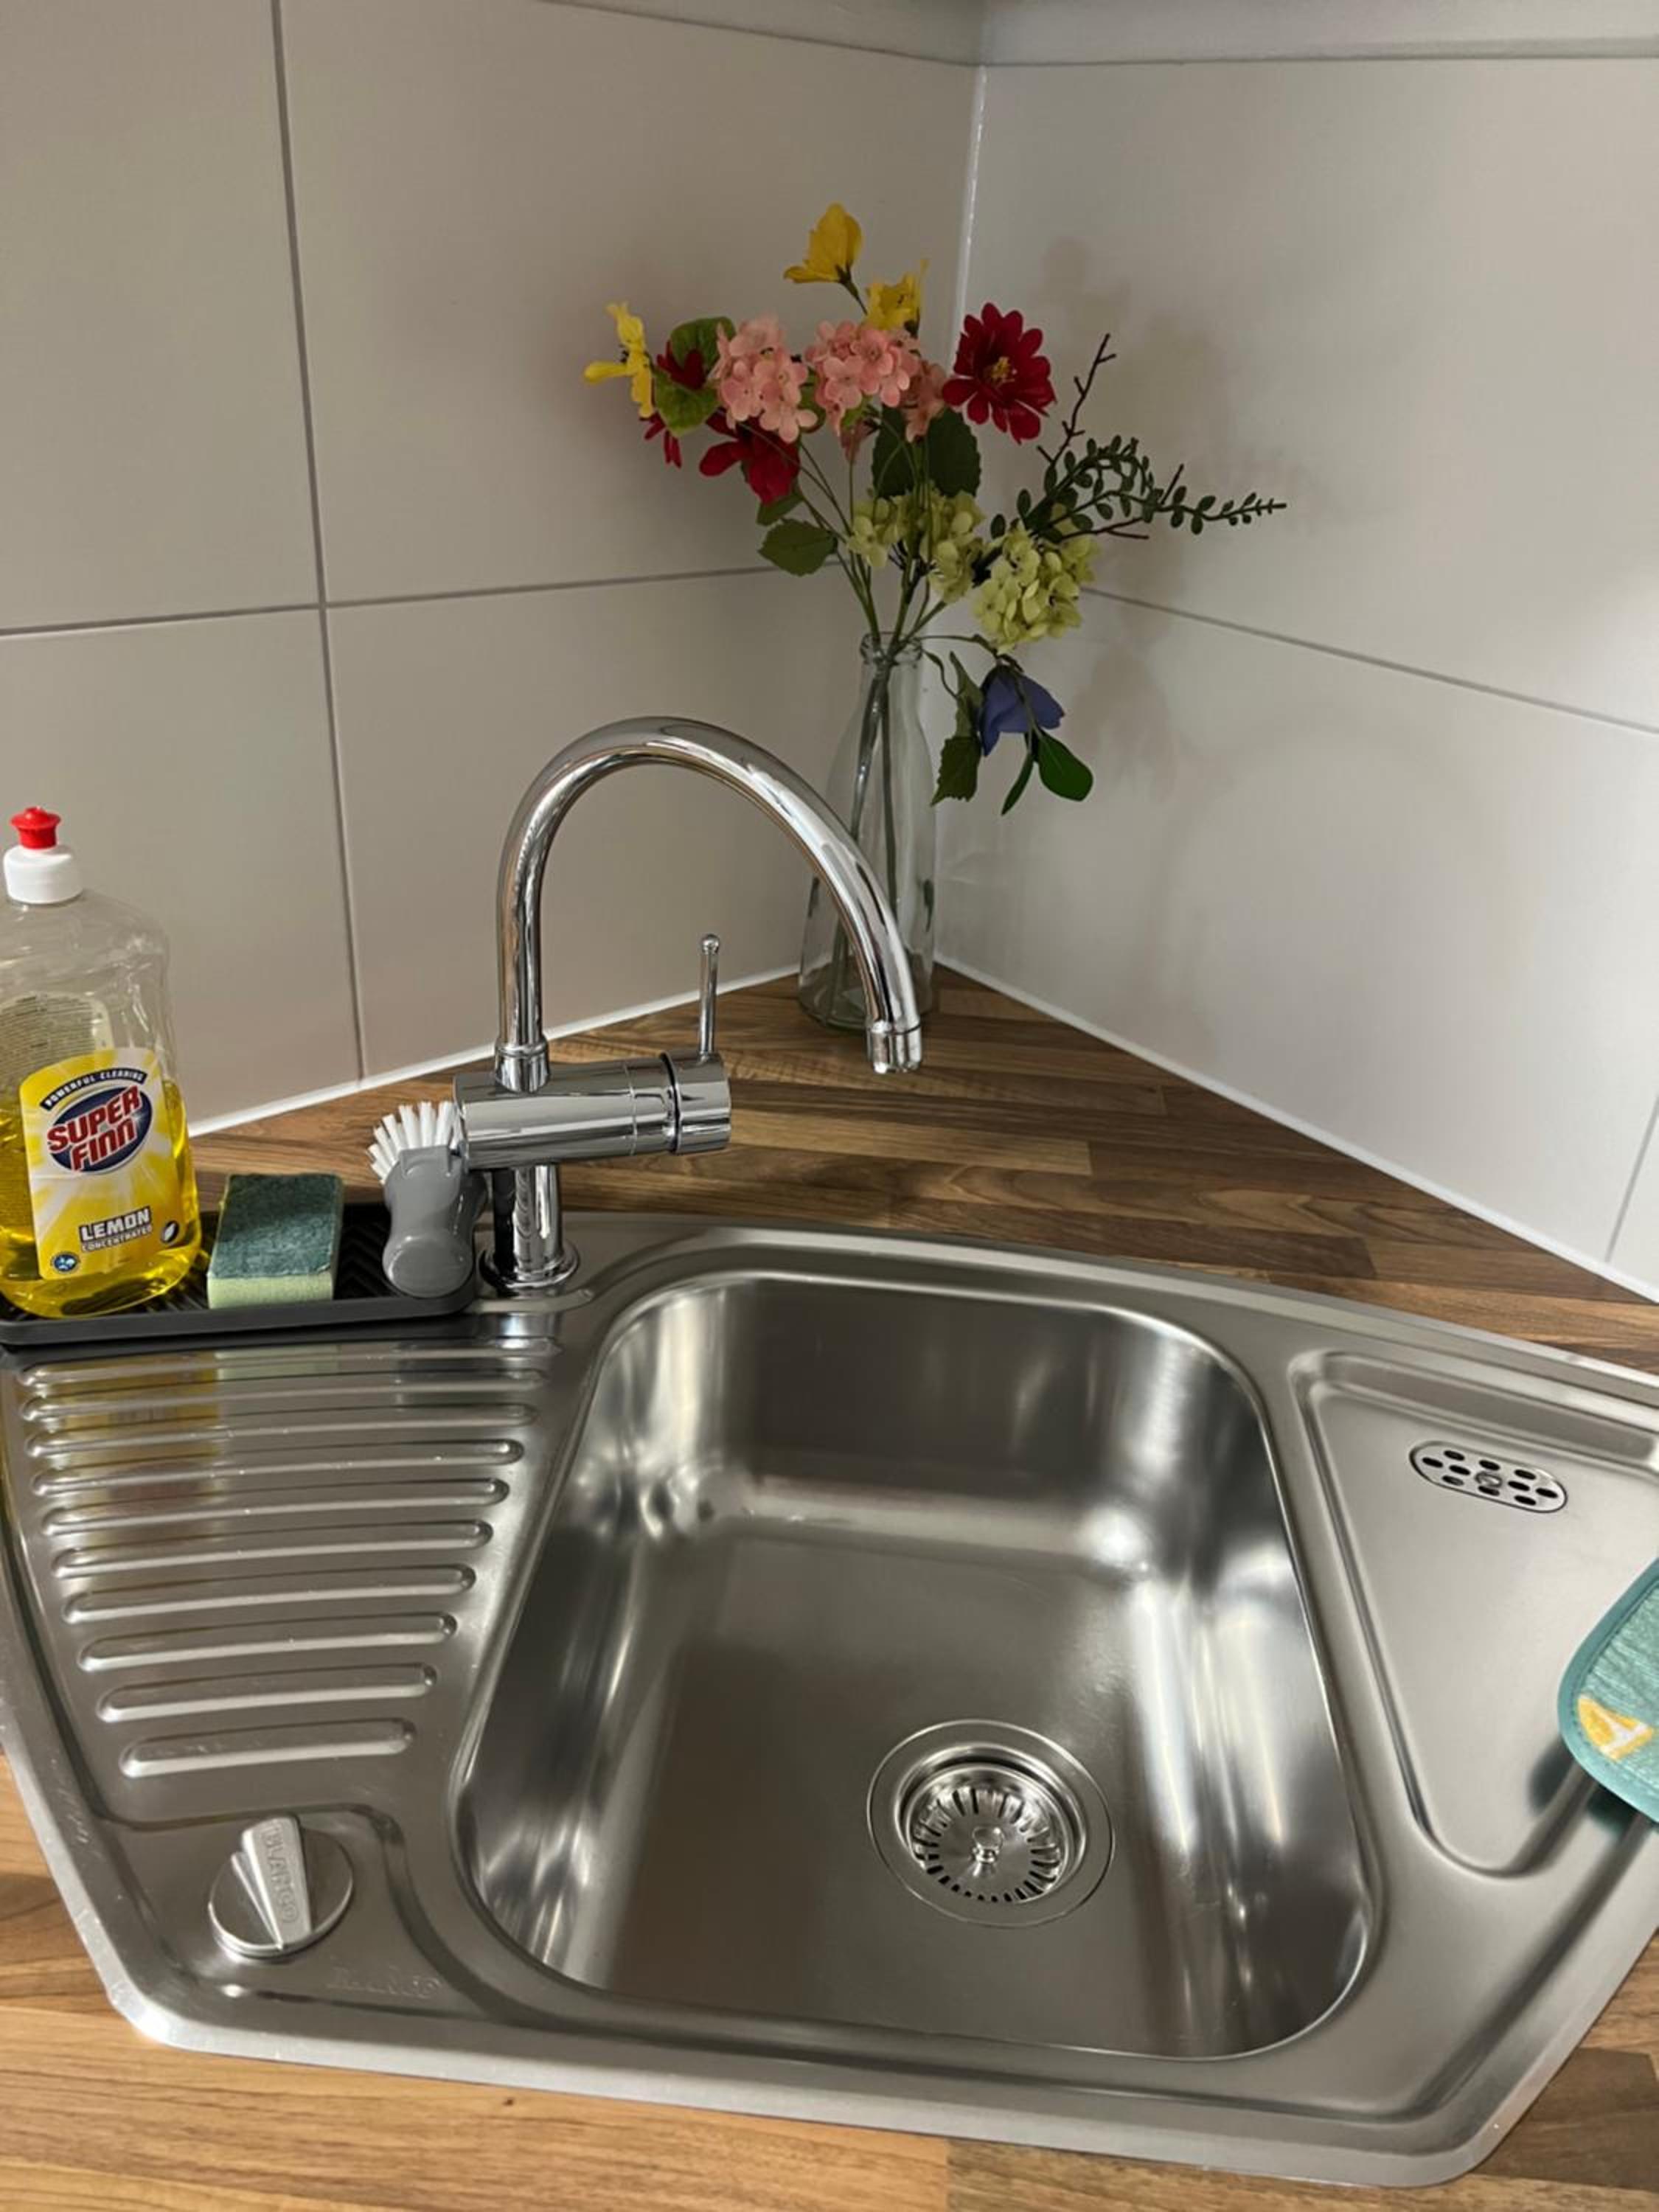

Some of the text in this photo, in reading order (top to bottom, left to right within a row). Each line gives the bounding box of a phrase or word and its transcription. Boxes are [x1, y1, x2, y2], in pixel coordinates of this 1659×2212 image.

[44, 1070, 144, 1107] POWERFUL CLEANING
[47, 1085, 142, 1153] SUPER
[81, 1208, 150, 1241] LEMON
